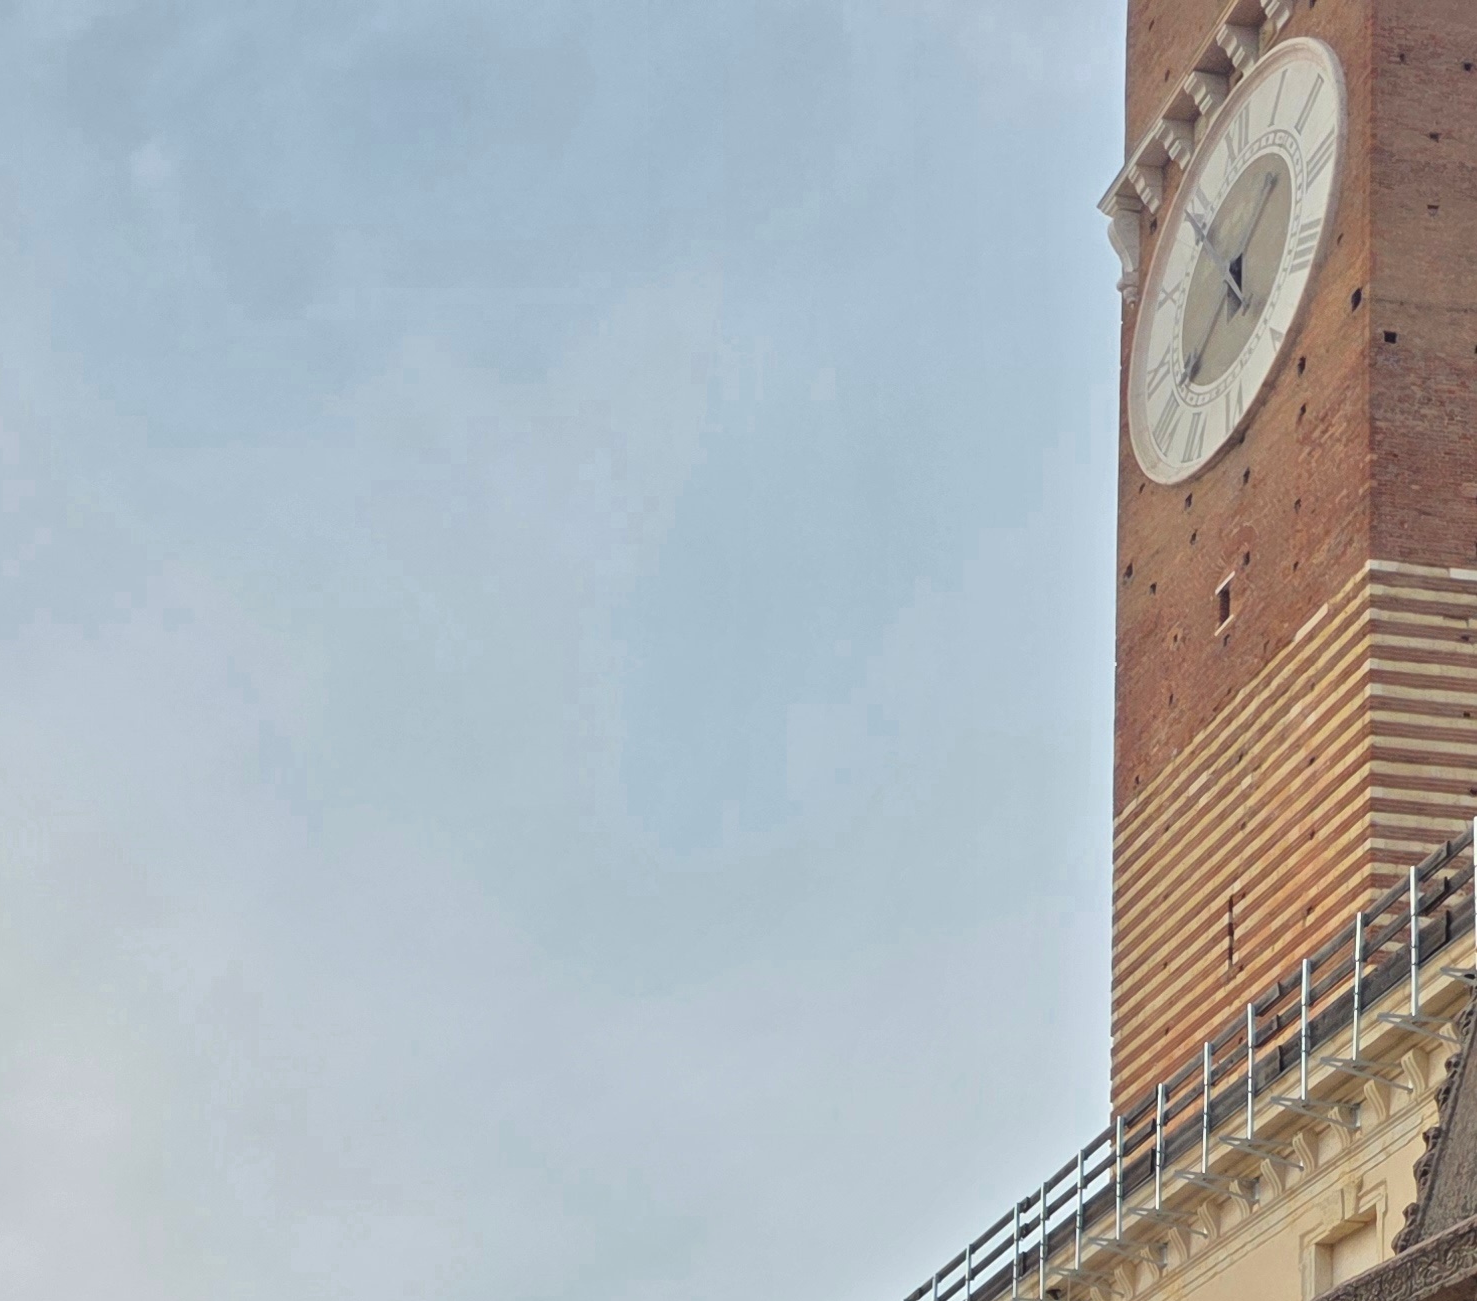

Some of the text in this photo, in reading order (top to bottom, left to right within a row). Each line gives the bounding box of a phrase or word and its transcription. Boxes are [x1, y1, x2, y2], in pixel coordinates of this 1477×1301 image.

[1268, 68, 1289, 129] I
[1294, 72, 1325, 136] II
[1304, 123, 1336, 195] III
